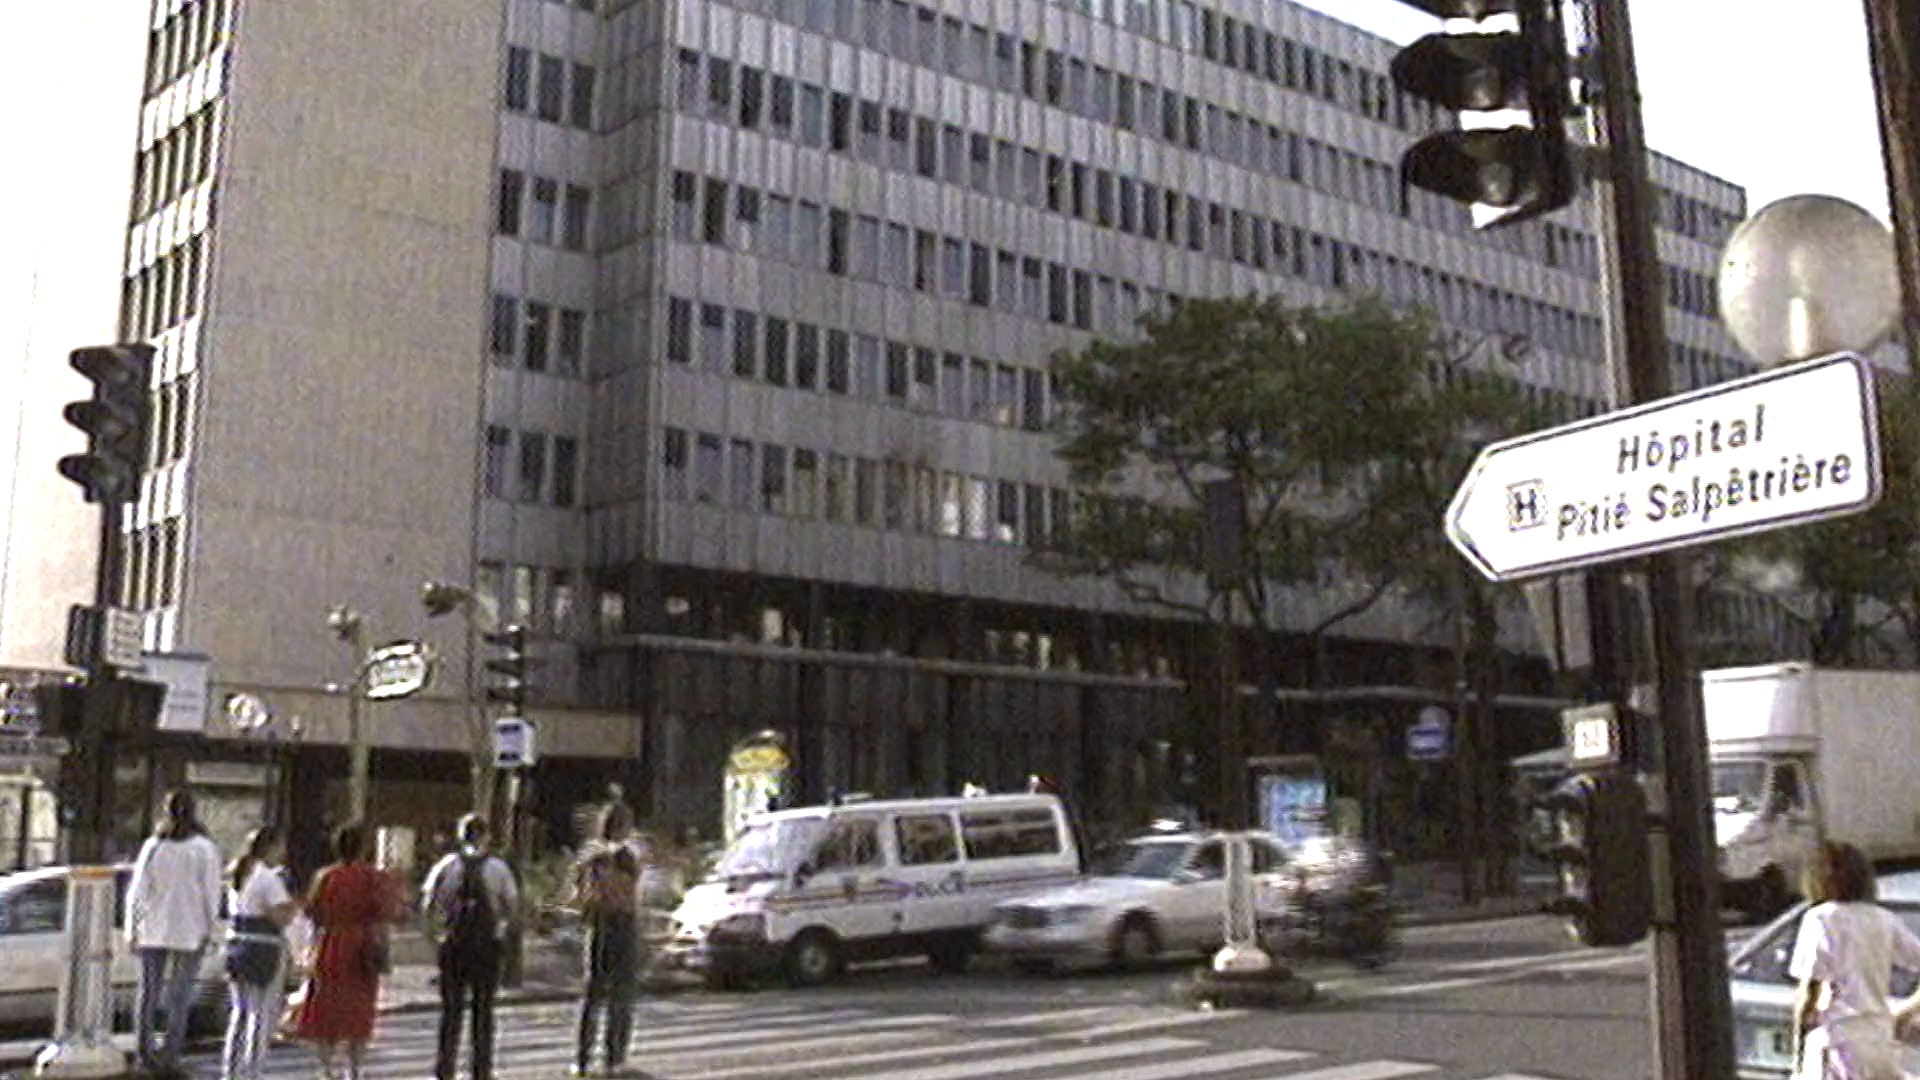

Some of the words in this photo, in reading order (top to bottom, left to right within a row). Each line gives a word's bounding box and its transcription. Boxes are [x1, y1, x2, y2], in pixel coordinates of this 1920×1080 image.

[1617, 404, 1766, 474] Hôpital
[1513, 488, 1538, 523] H
[1556, 491, 1632, 541] Pitié
[1645, 454, 1852, 523] Salpêtrière
